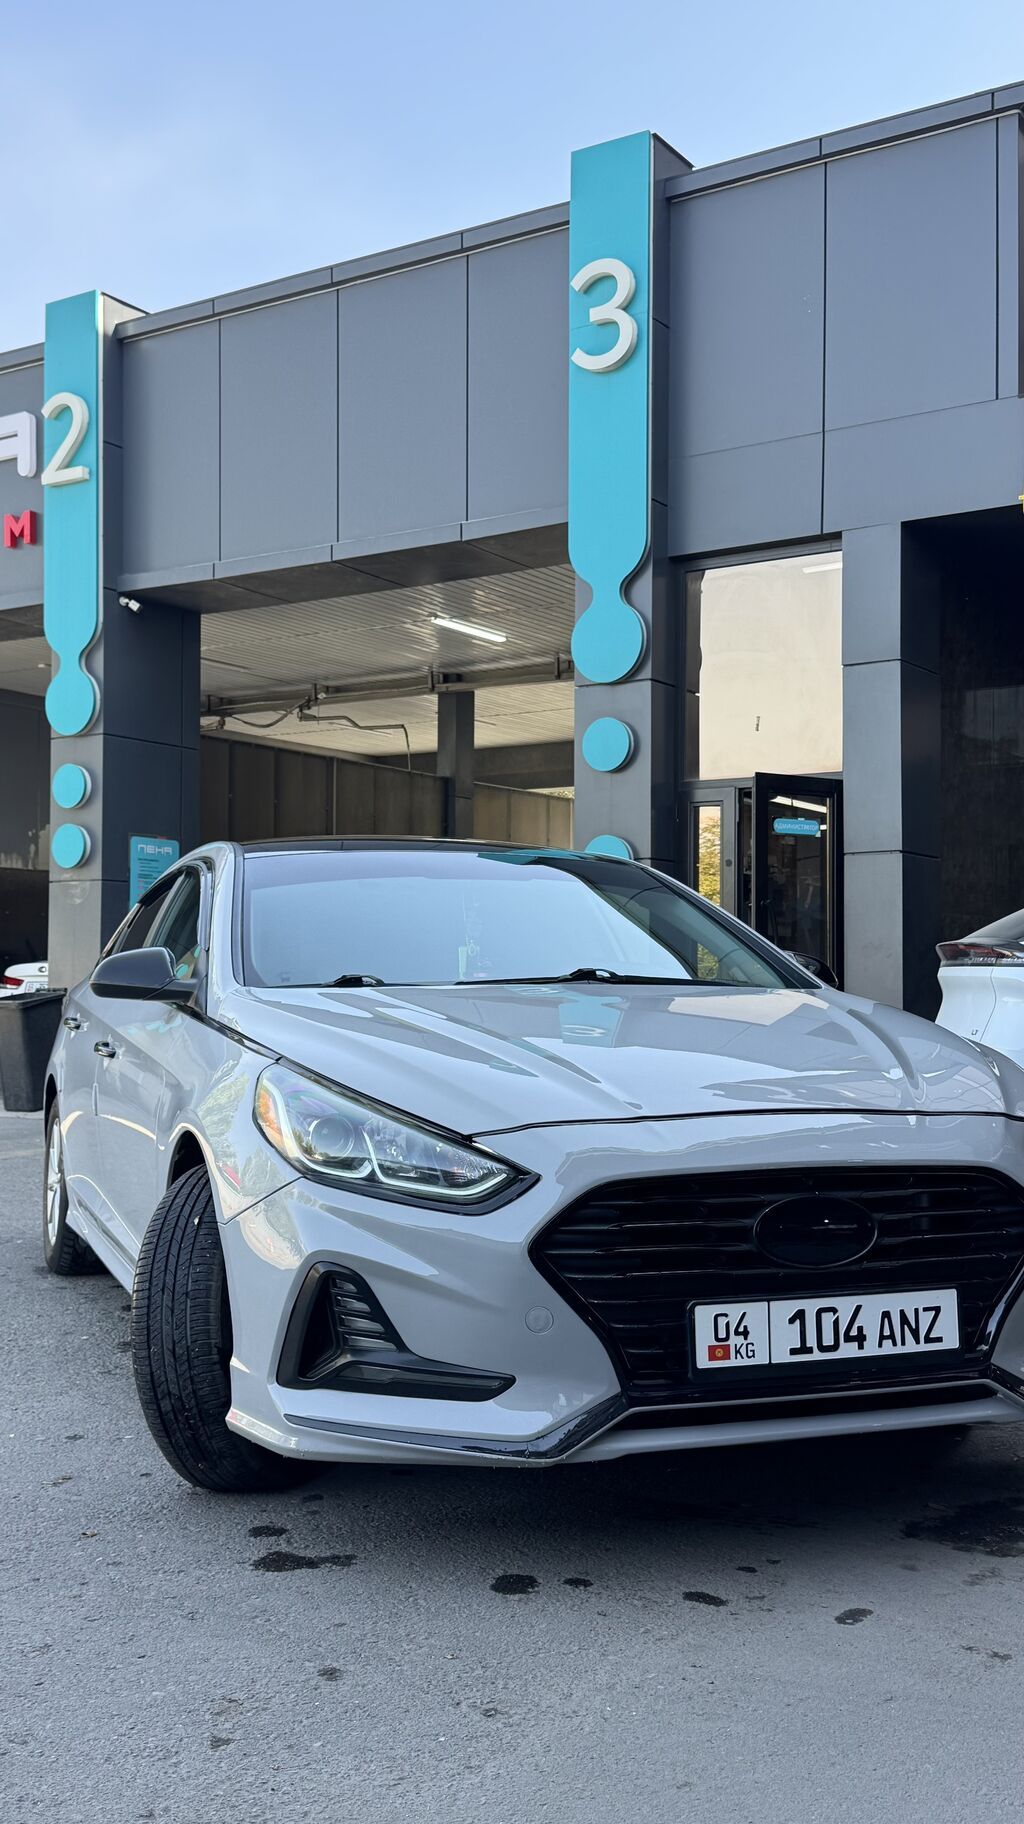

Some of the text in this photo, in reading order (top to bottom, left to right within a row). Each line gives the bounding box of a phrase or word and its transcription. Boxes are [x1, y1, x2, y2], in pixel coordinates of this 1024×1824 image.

[570, 257, 638, 373] 3
[41, 392, 90, 486] 2
[137, 844, 173, 856] ПЕНА
[713, 1304, 944, 1356] 04 104 ANZ
[734, 1342, 756, 1360] KG
